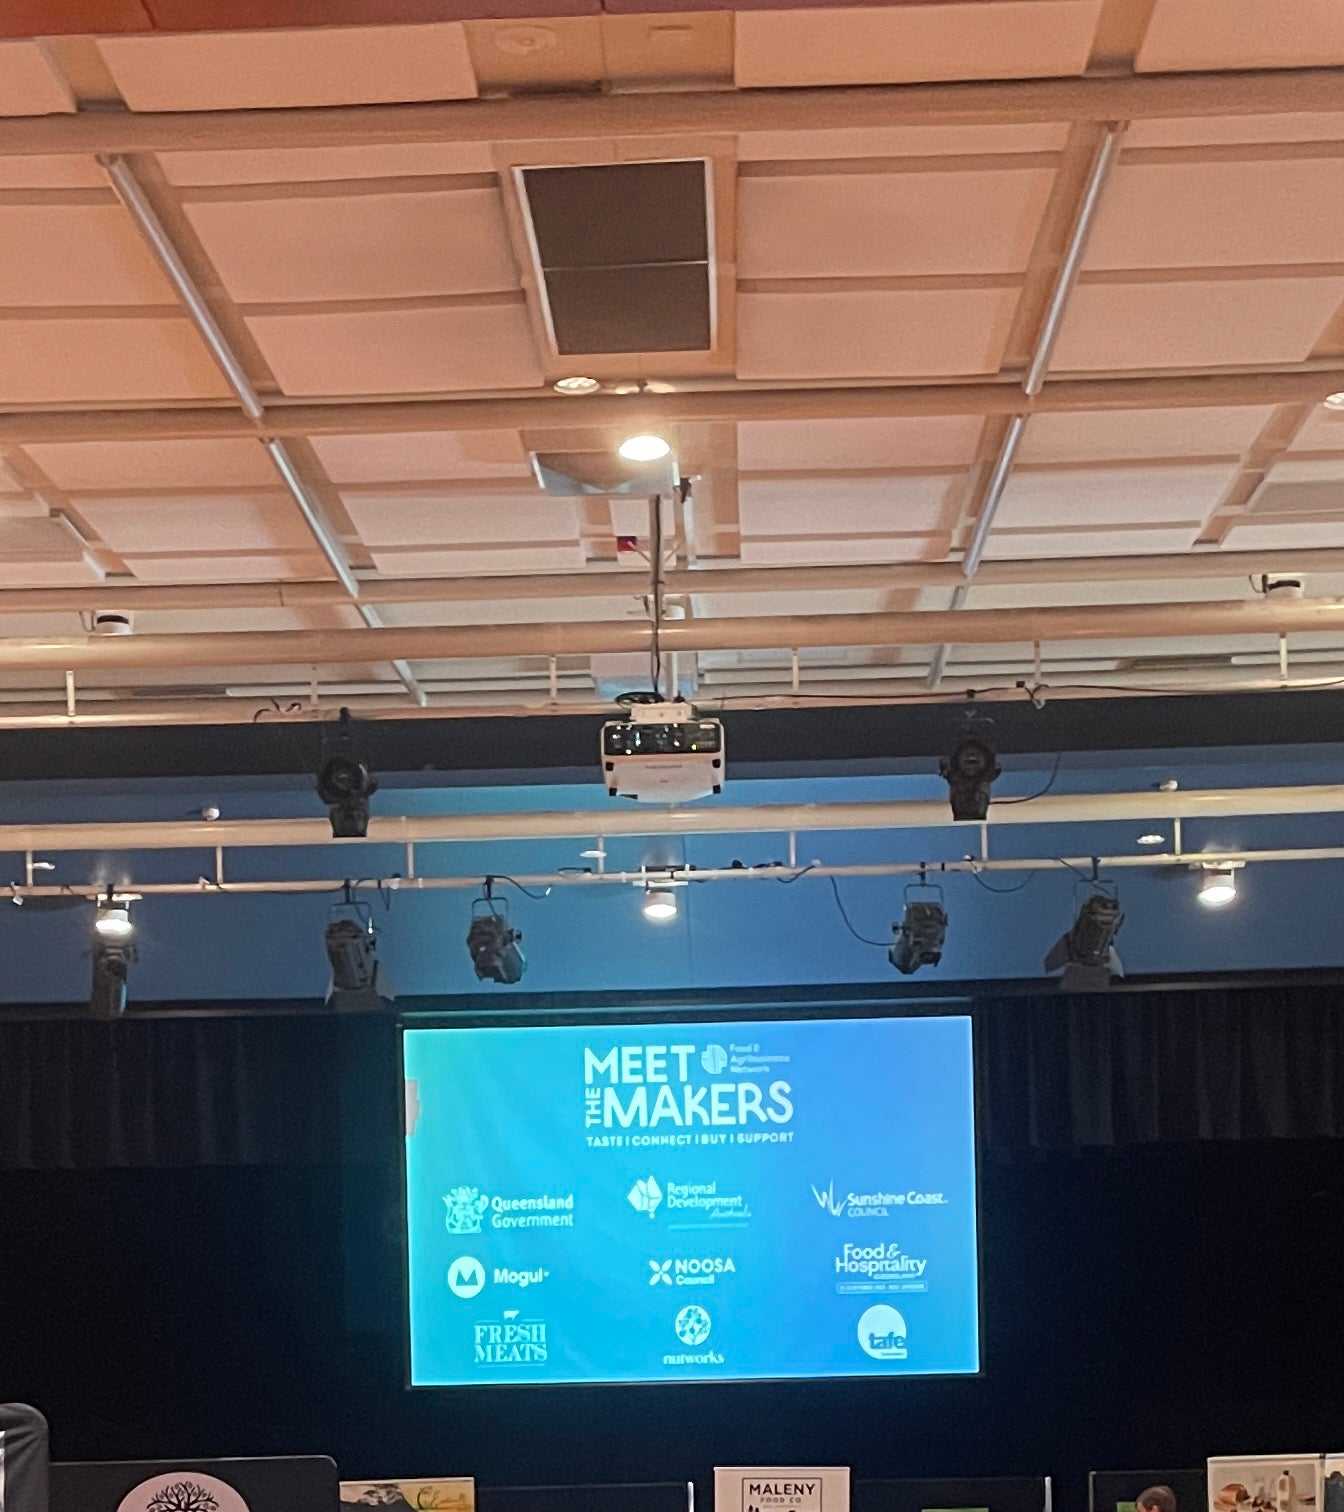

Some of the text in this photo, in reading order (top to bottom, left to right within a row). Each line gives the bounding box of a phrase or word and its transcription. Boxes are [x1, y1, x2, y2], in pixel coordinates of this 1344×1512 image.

[584, 1045, 696, 1084] MEET
[585, 1087, 601, 1129] THE
[603, 1080, 794, 1128] MAKERS
[586, 1132, 794, 1147] TASTE CONNECT BUY SUPPORT
[667, 1182, 716, 1198] Regional
[491, 1194, 574, 1212] Queensland
[667, 1195, 743, 1210] Development
[847, 1191, 944, 1206] Sunshine Coast
[848, 1207, 889, 1217] COUNCIL
[492, 1214, 574, 1228] Government
[844, 1243, 901, 1260] Food &
[675, 1258, 736, 1273] NOOSA
[836, 1255, 927, 1276] Hospitality
[494, 1268, 544, 1287] Mogul
[675, 1274, 715, 1285] Council
[474, 1324, 547, 1343] FRESH
[869, 1332, 905, 1349] tafe
[474, 1343, 548, 1363] MEATS
[663, 1351, 724, 1364] nutworks
[749, 1483, 816, 1496] MALENY
